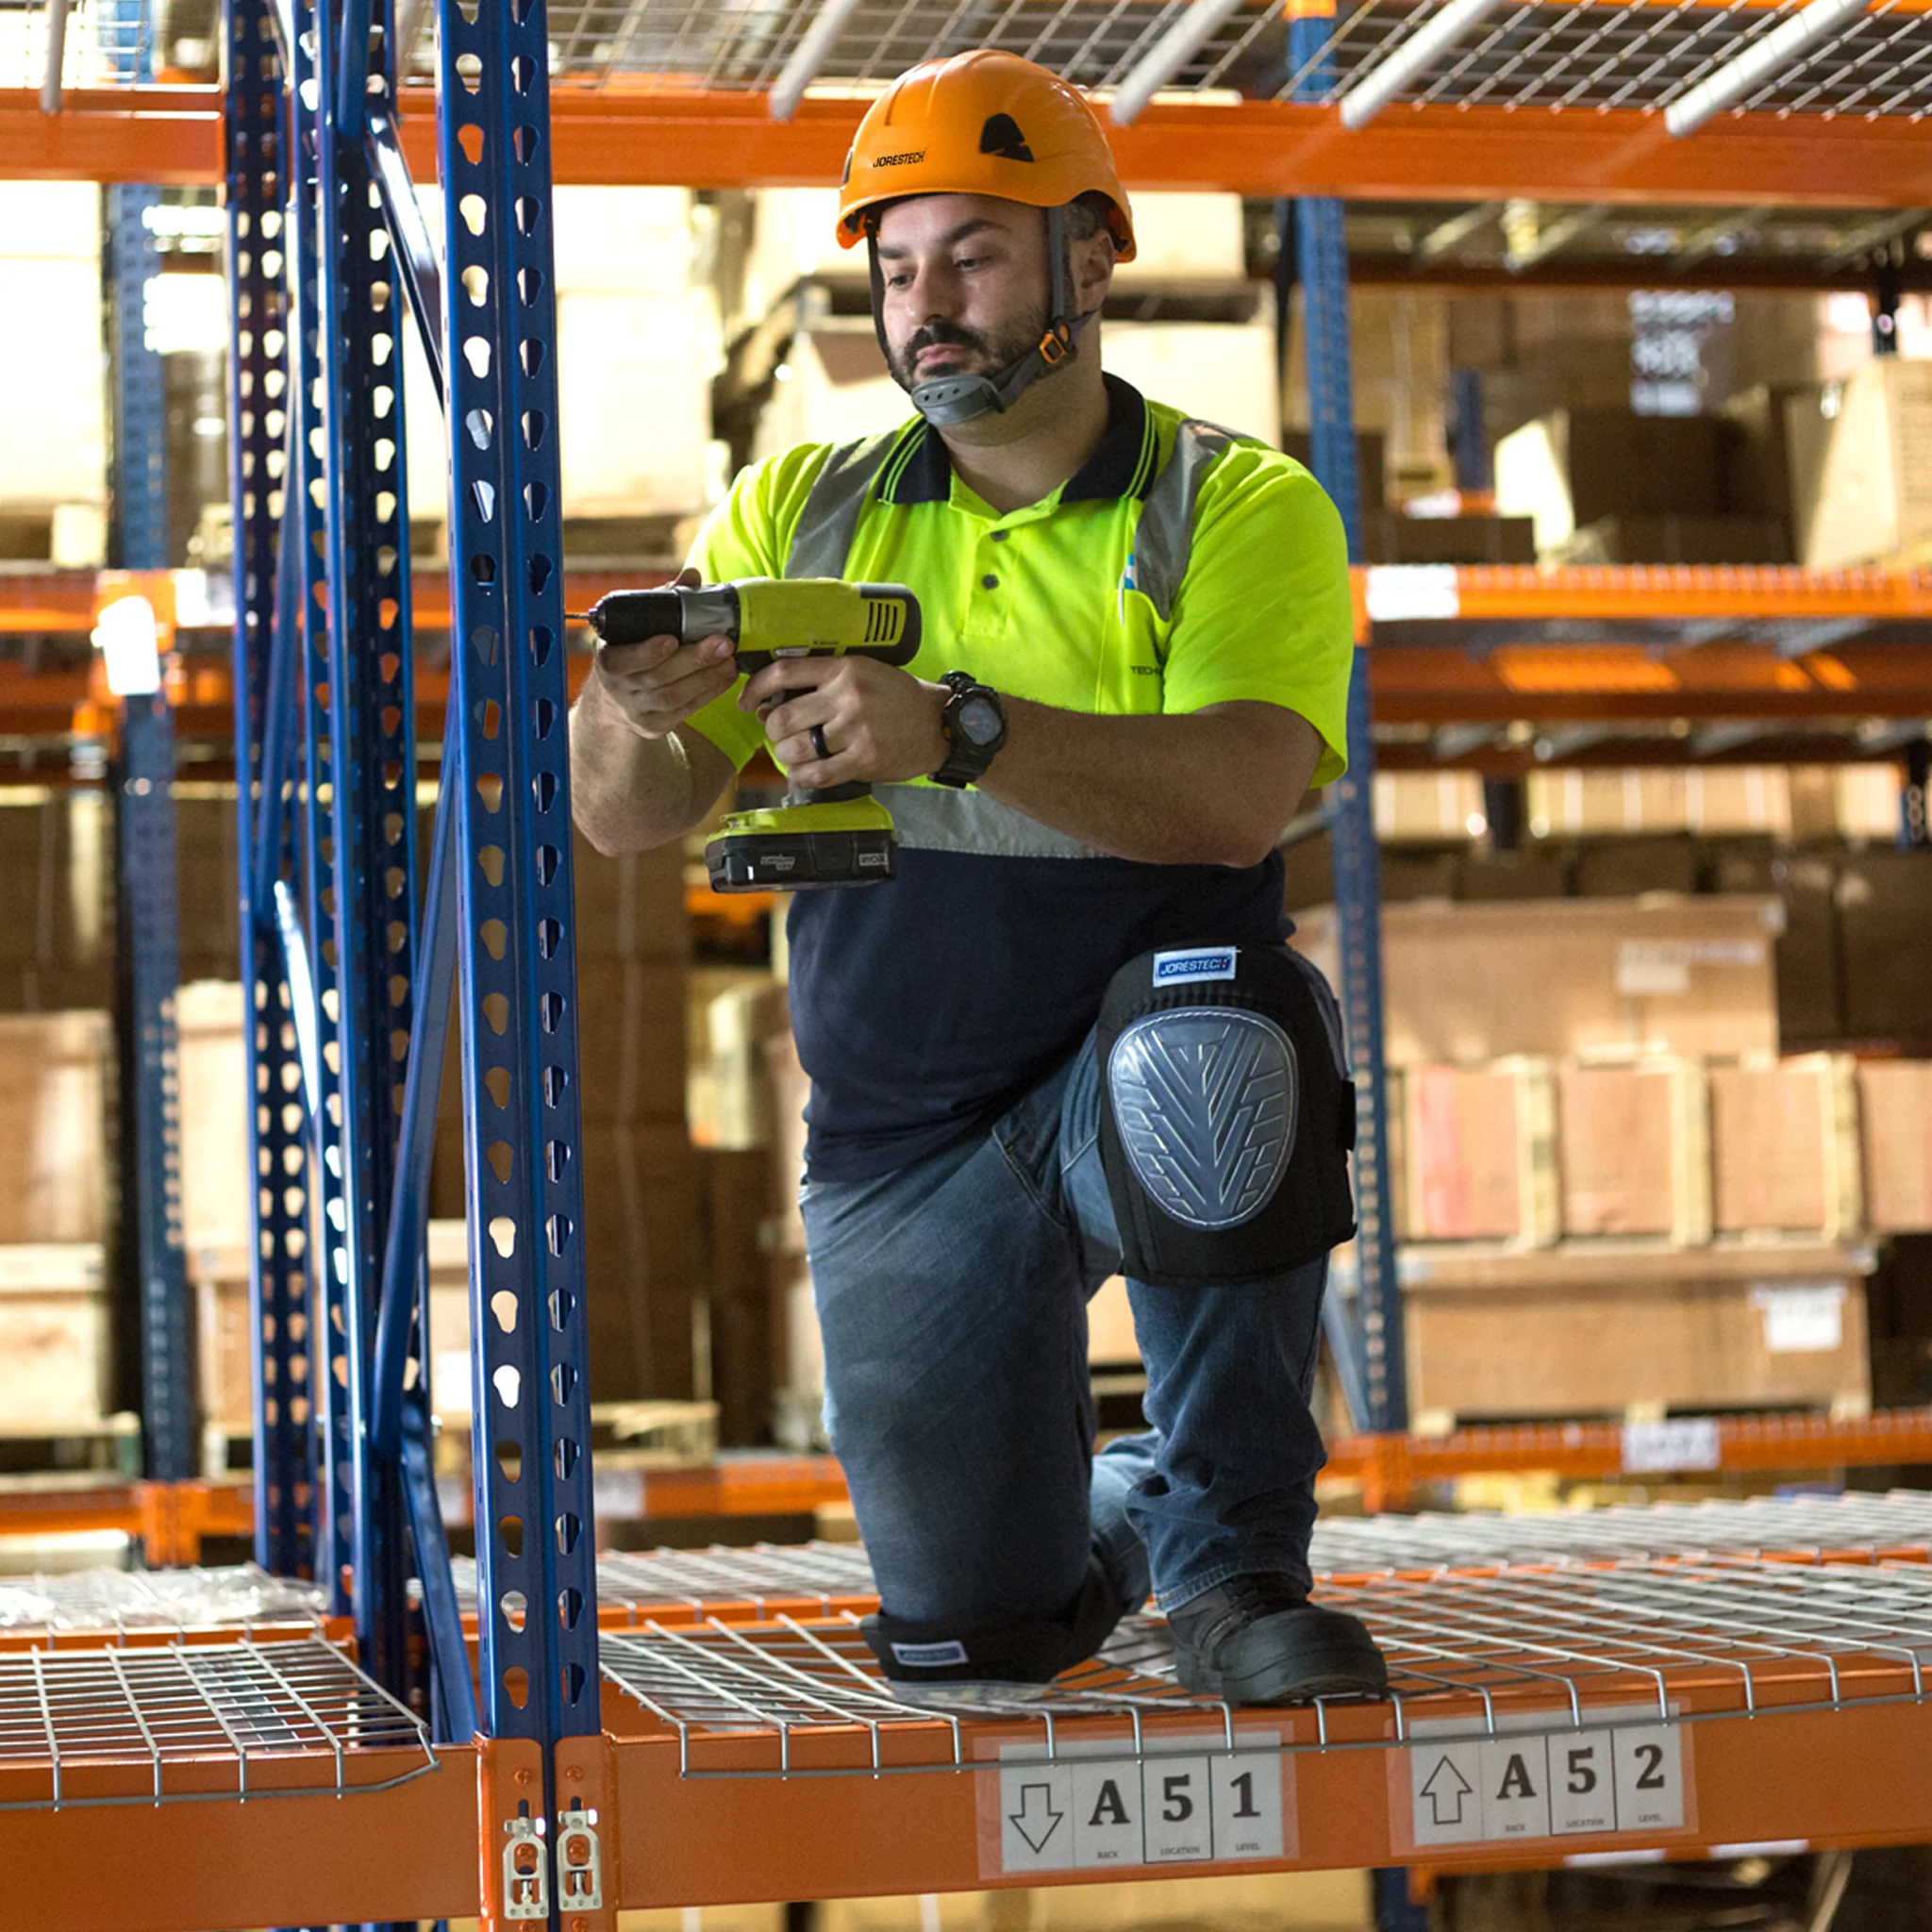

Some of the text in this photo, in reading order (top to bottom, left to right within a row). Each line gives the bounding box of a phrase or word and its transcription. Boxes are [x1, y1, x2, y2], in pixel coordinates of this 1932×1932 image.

[873, 151, 925, 168] JORESTECH
[1160, 958, 1227, 975] JORESTECH
[1496, 1744, 1665, 1800] A 5 2
[1088, 1772, 1261, 1826] A 5 1
[1565, 1818, 1606, 1828] LOCATION
[1638, 1814, 1663, 1824] LEVEL
[1159, 1845, 1201, 1857] LOCATION
[1235, 1842, 1261, 1853] LEVEL
